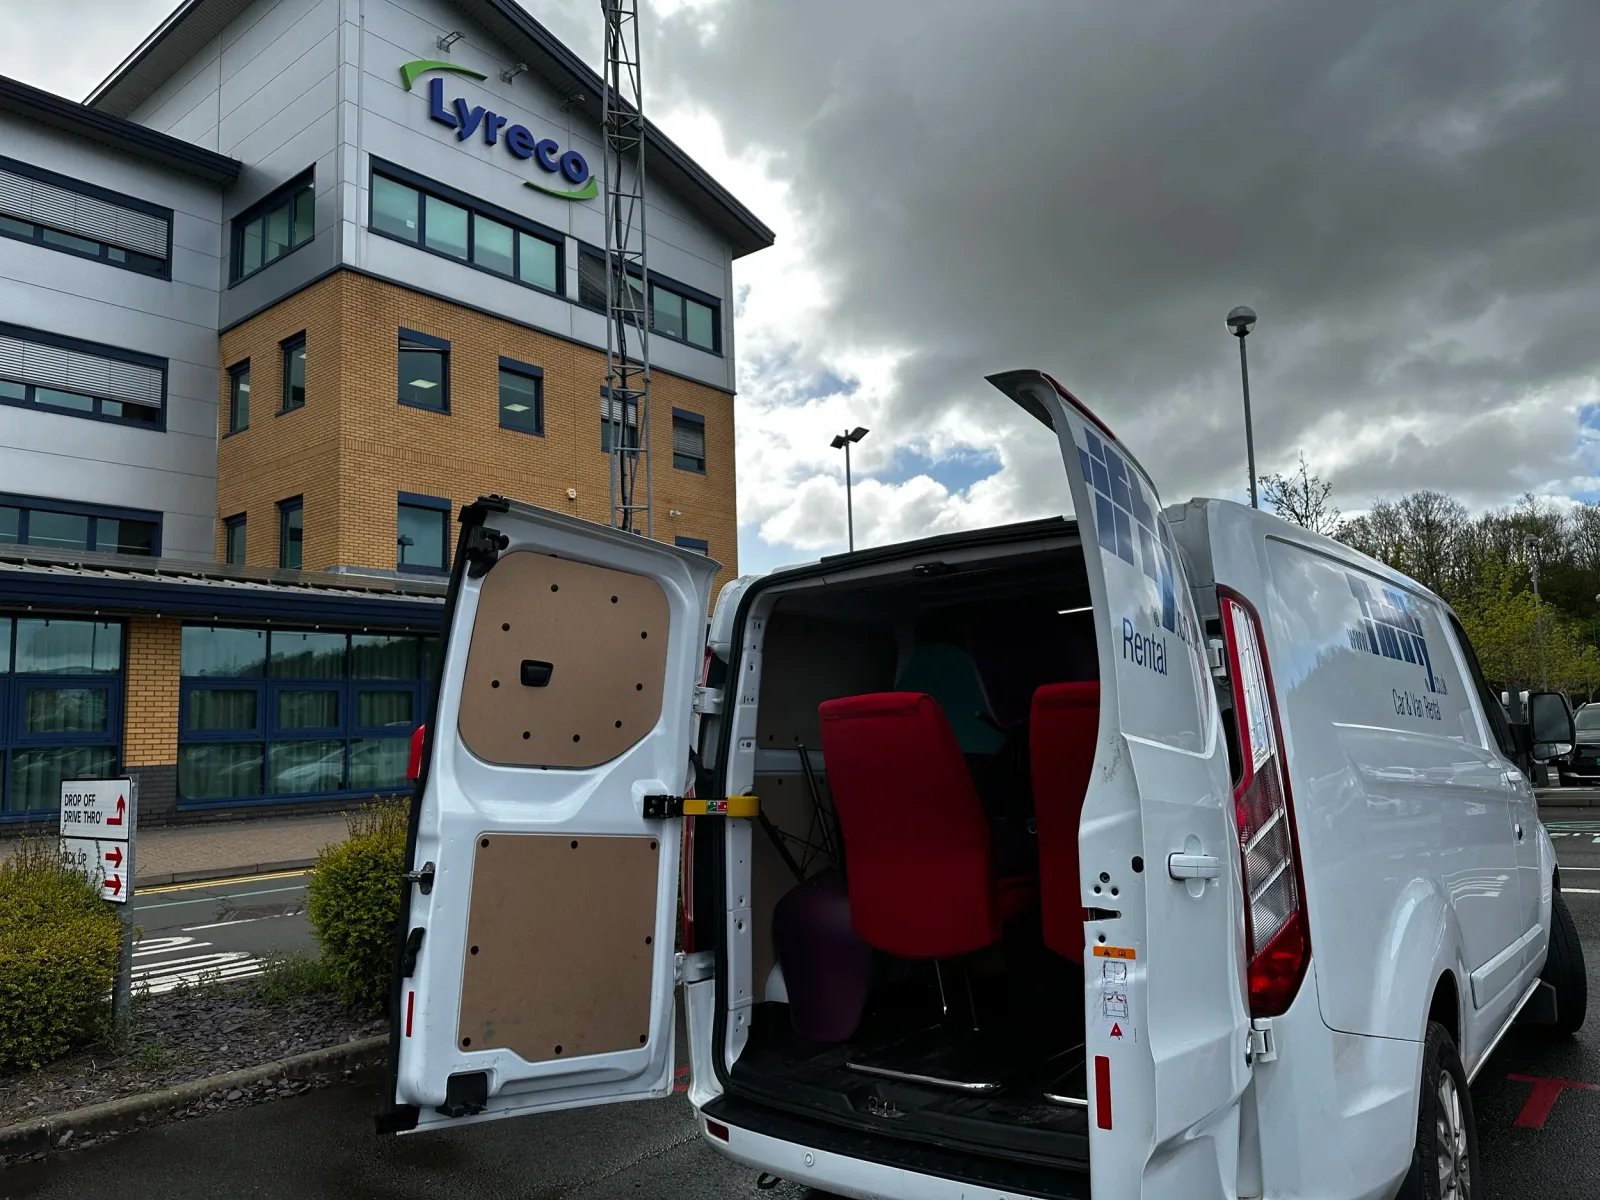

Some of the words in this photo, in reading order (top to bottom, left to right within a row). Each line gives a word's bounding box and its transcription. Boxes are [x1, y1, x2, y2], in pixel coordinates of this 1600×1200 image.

[430, 77, 589, 184] Lyreco
[1123, 616, 1168, 676] Rental
[1392, 688, 1405, 715] Car
[1409, 691, 1424, 718] Van
[1423, 695, 1441, 721] Rental
[64, 794, 81, 807] DROP
[83, 794, 96, 807] OFF
[64, 811, 81, 824] DRIVE
